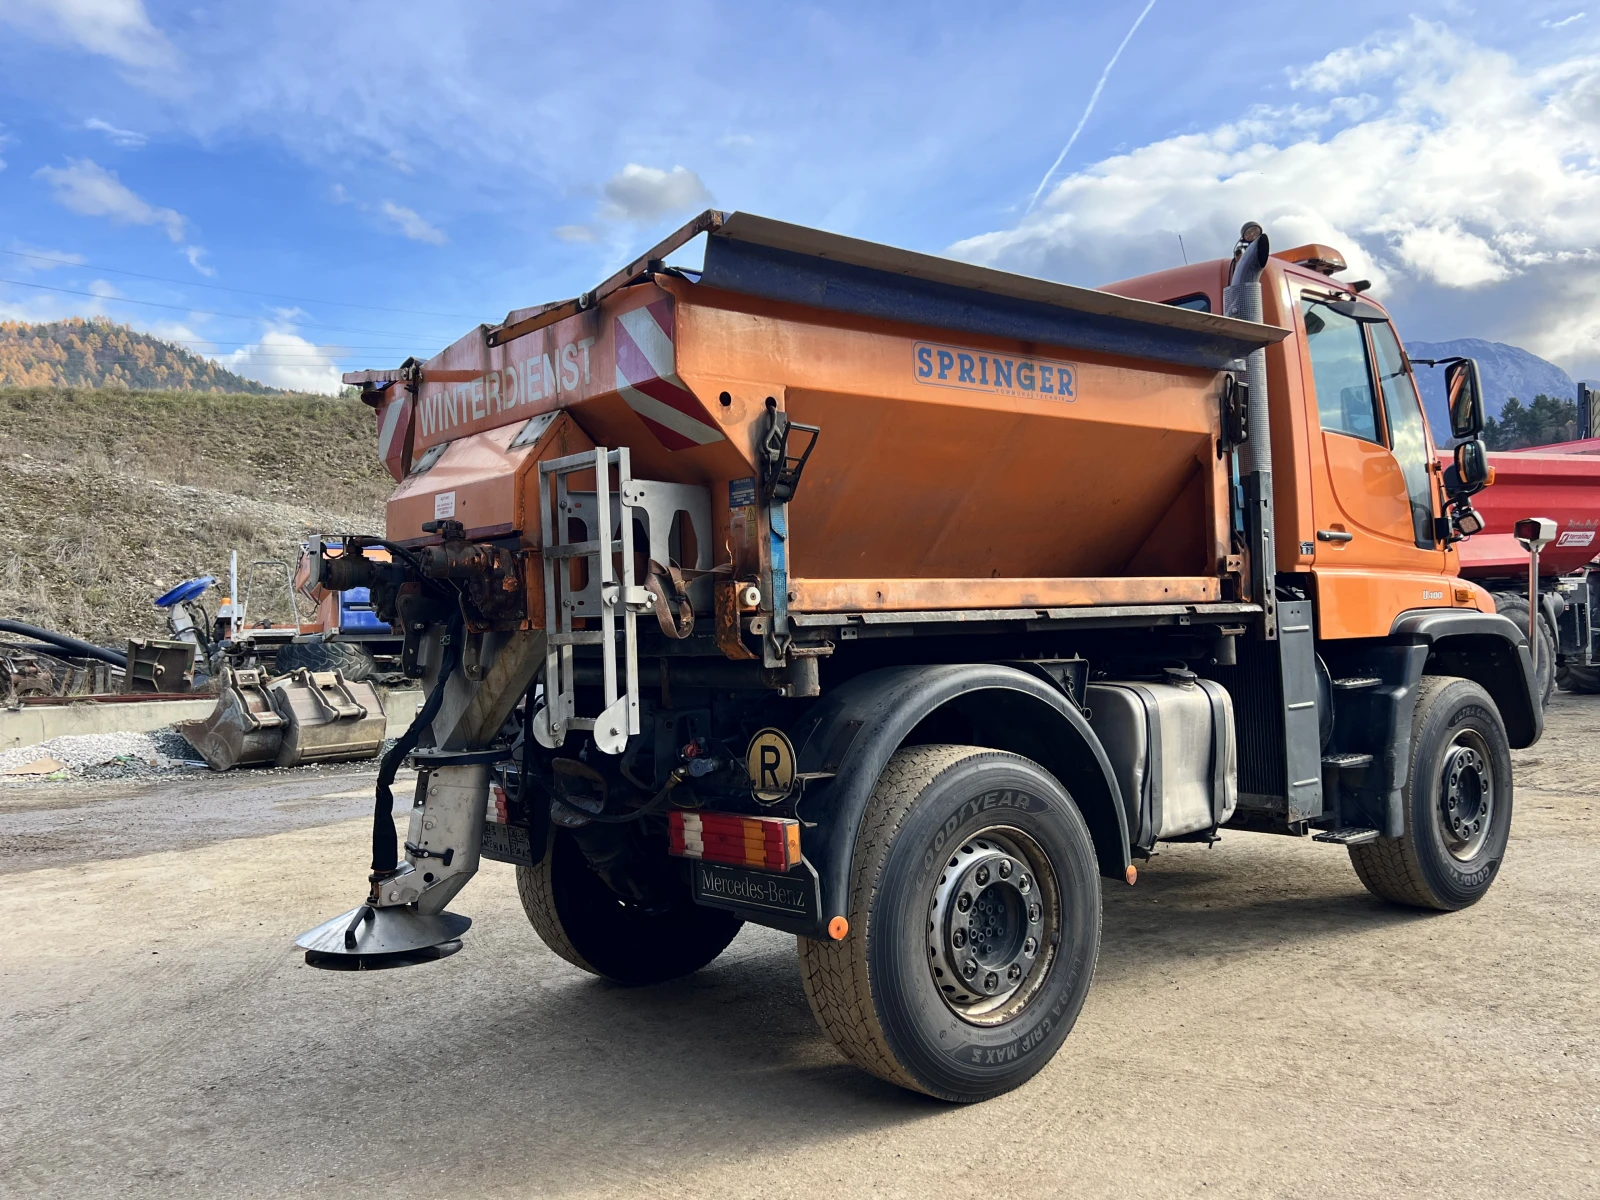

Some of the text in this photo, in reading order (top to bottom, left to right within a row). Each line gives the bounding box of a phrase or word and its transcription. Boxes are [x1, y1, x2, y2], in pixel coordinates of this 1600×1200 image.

[419, 336, 595, 437] WINTERDIENST
[917, 347, 1074, 397] SPRINGER
[760, 744, 781, 788] R
[916, 790, 1031, 891] GOODYEAR
[702, 869, 806, 908] Mercedes-Benz
[986, 1043, 1018, 1064] MAX
[1021, 1017, 1052, 1052] GRIP
